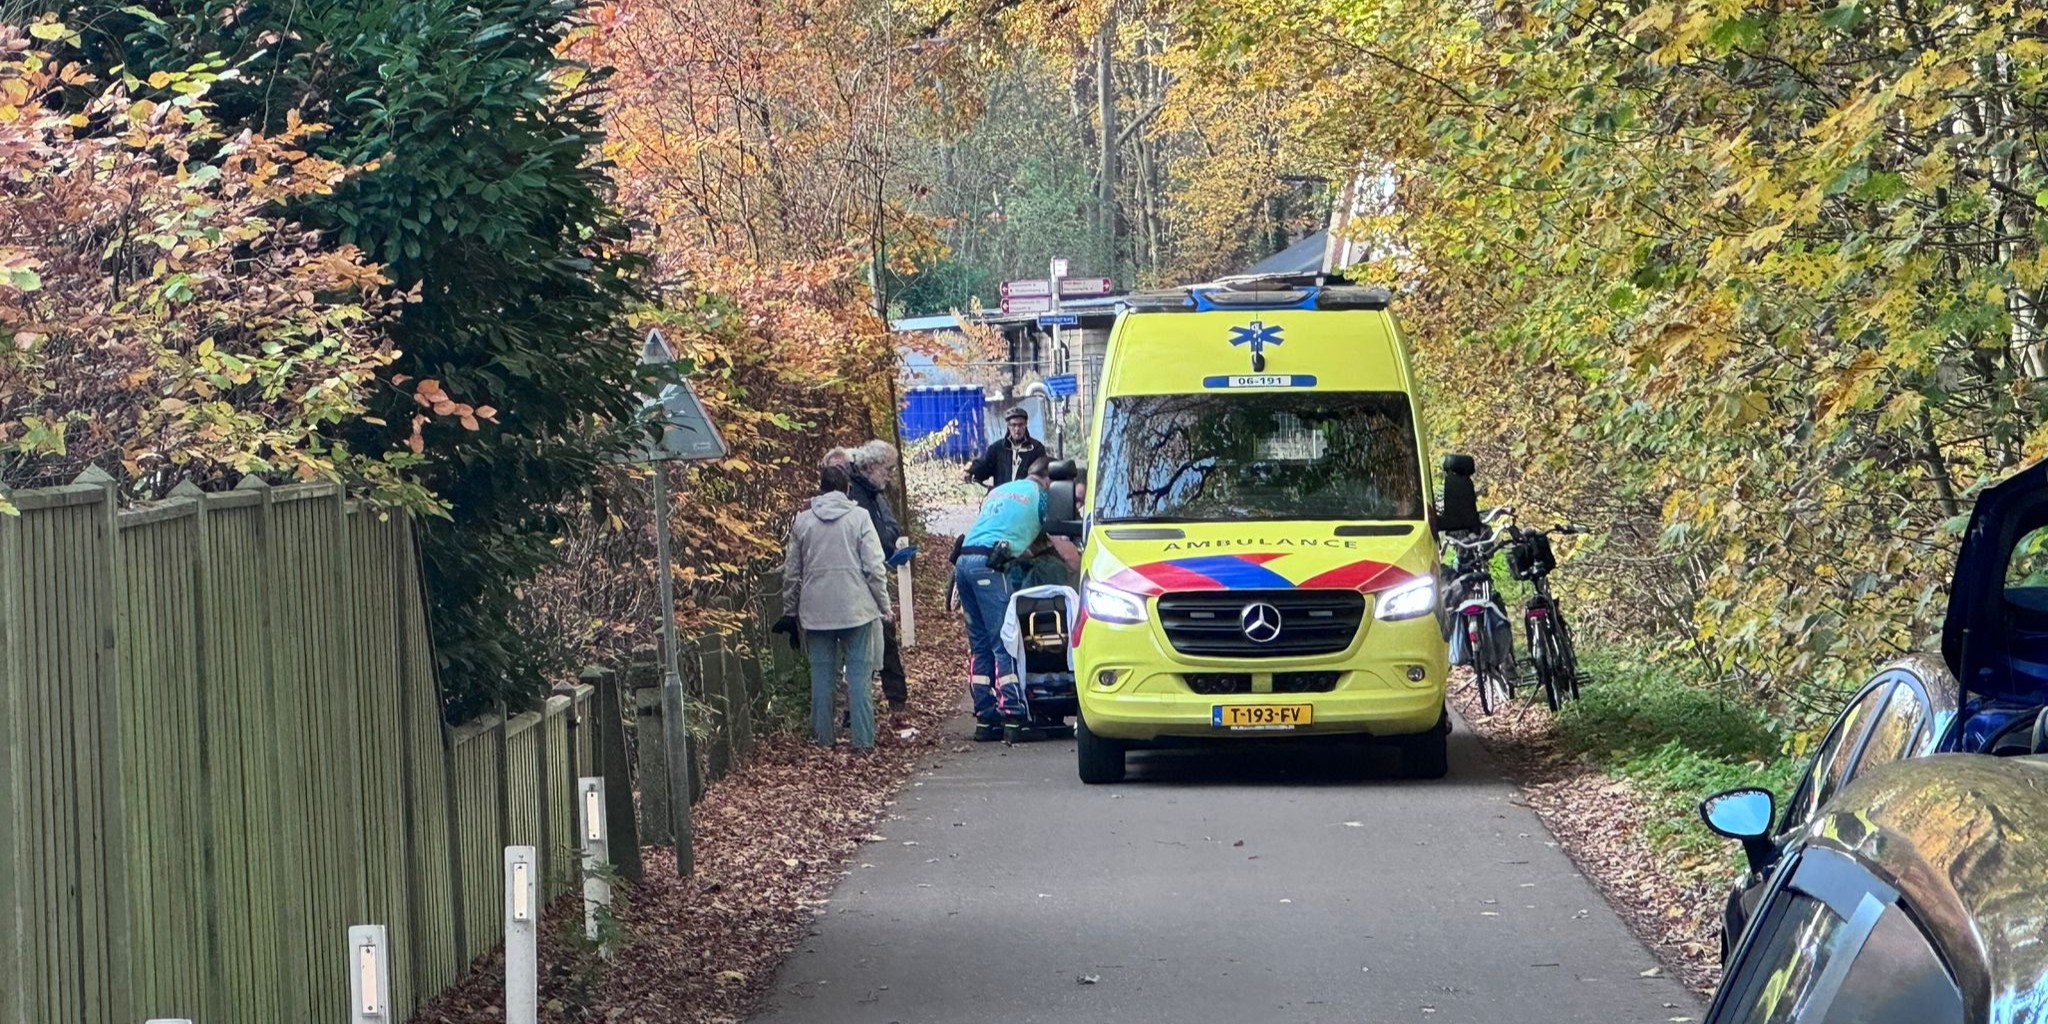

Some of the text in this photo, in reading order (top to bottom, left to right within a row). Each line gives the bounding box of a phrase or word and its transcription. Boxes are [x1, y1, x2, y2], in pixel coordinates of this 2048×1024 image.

[1238, 377, 1282, 385] 06-191
[1163, 538, 1358, 552] AMBULANCE
[1230, 707, 1301, 723] T-193-FV
